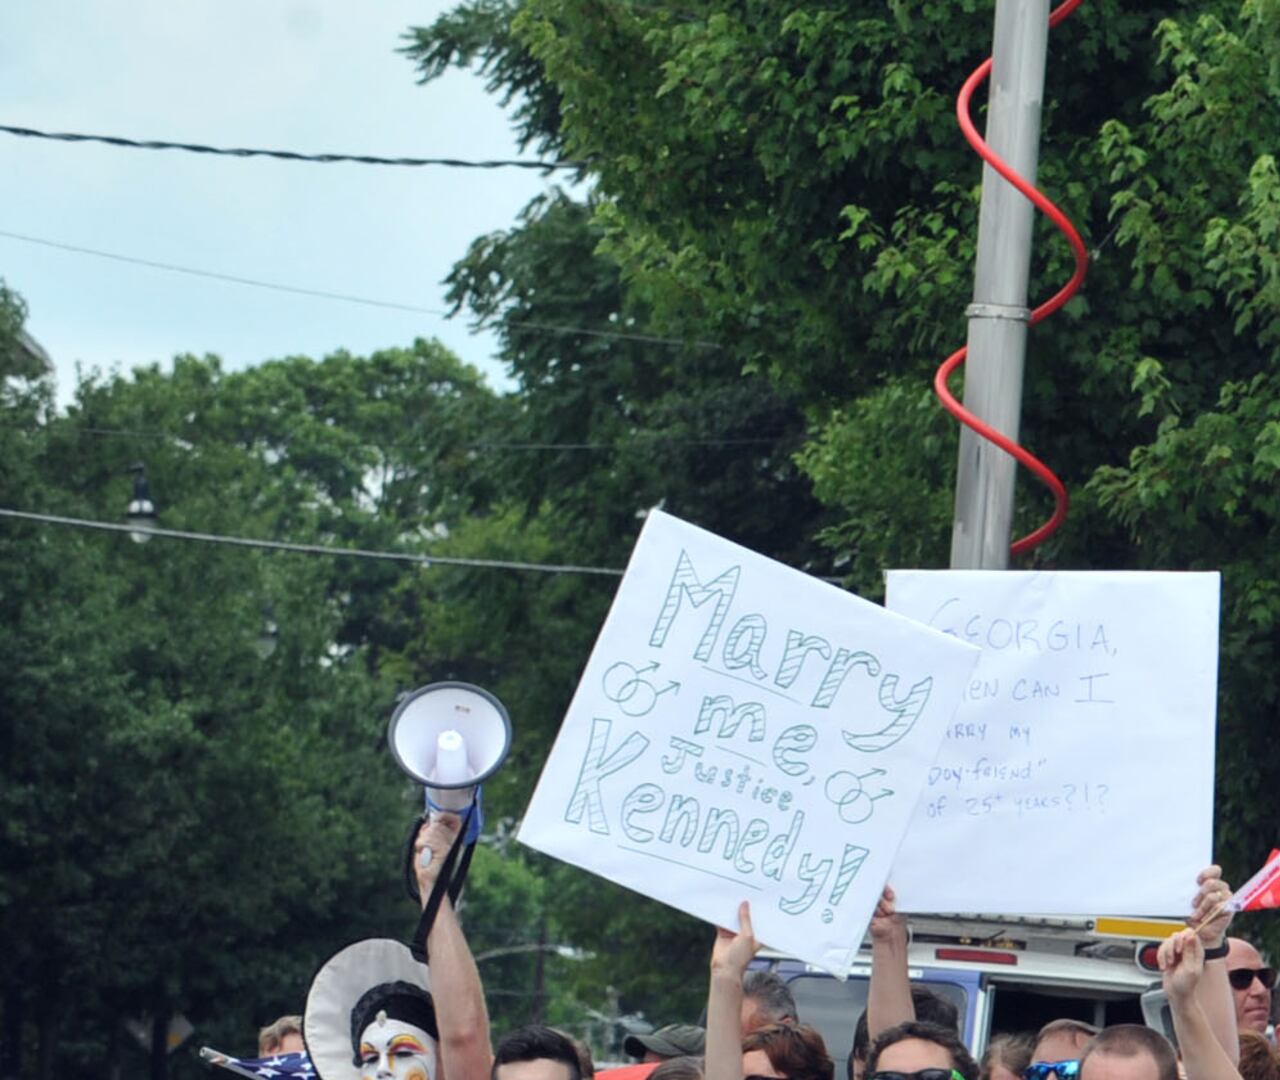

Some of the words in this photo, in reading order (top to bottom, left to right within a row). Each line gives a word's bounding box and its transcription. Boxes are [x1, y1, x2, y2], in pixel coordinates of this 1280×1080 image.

[649, 547, 934, 753] Marry
[1011, 677, 1060, 701] CAN
[1074, 672, 1114, 704] I
[564, 717, 871, 924] Kennedy!
[661, 735, 793, 808] Justice
